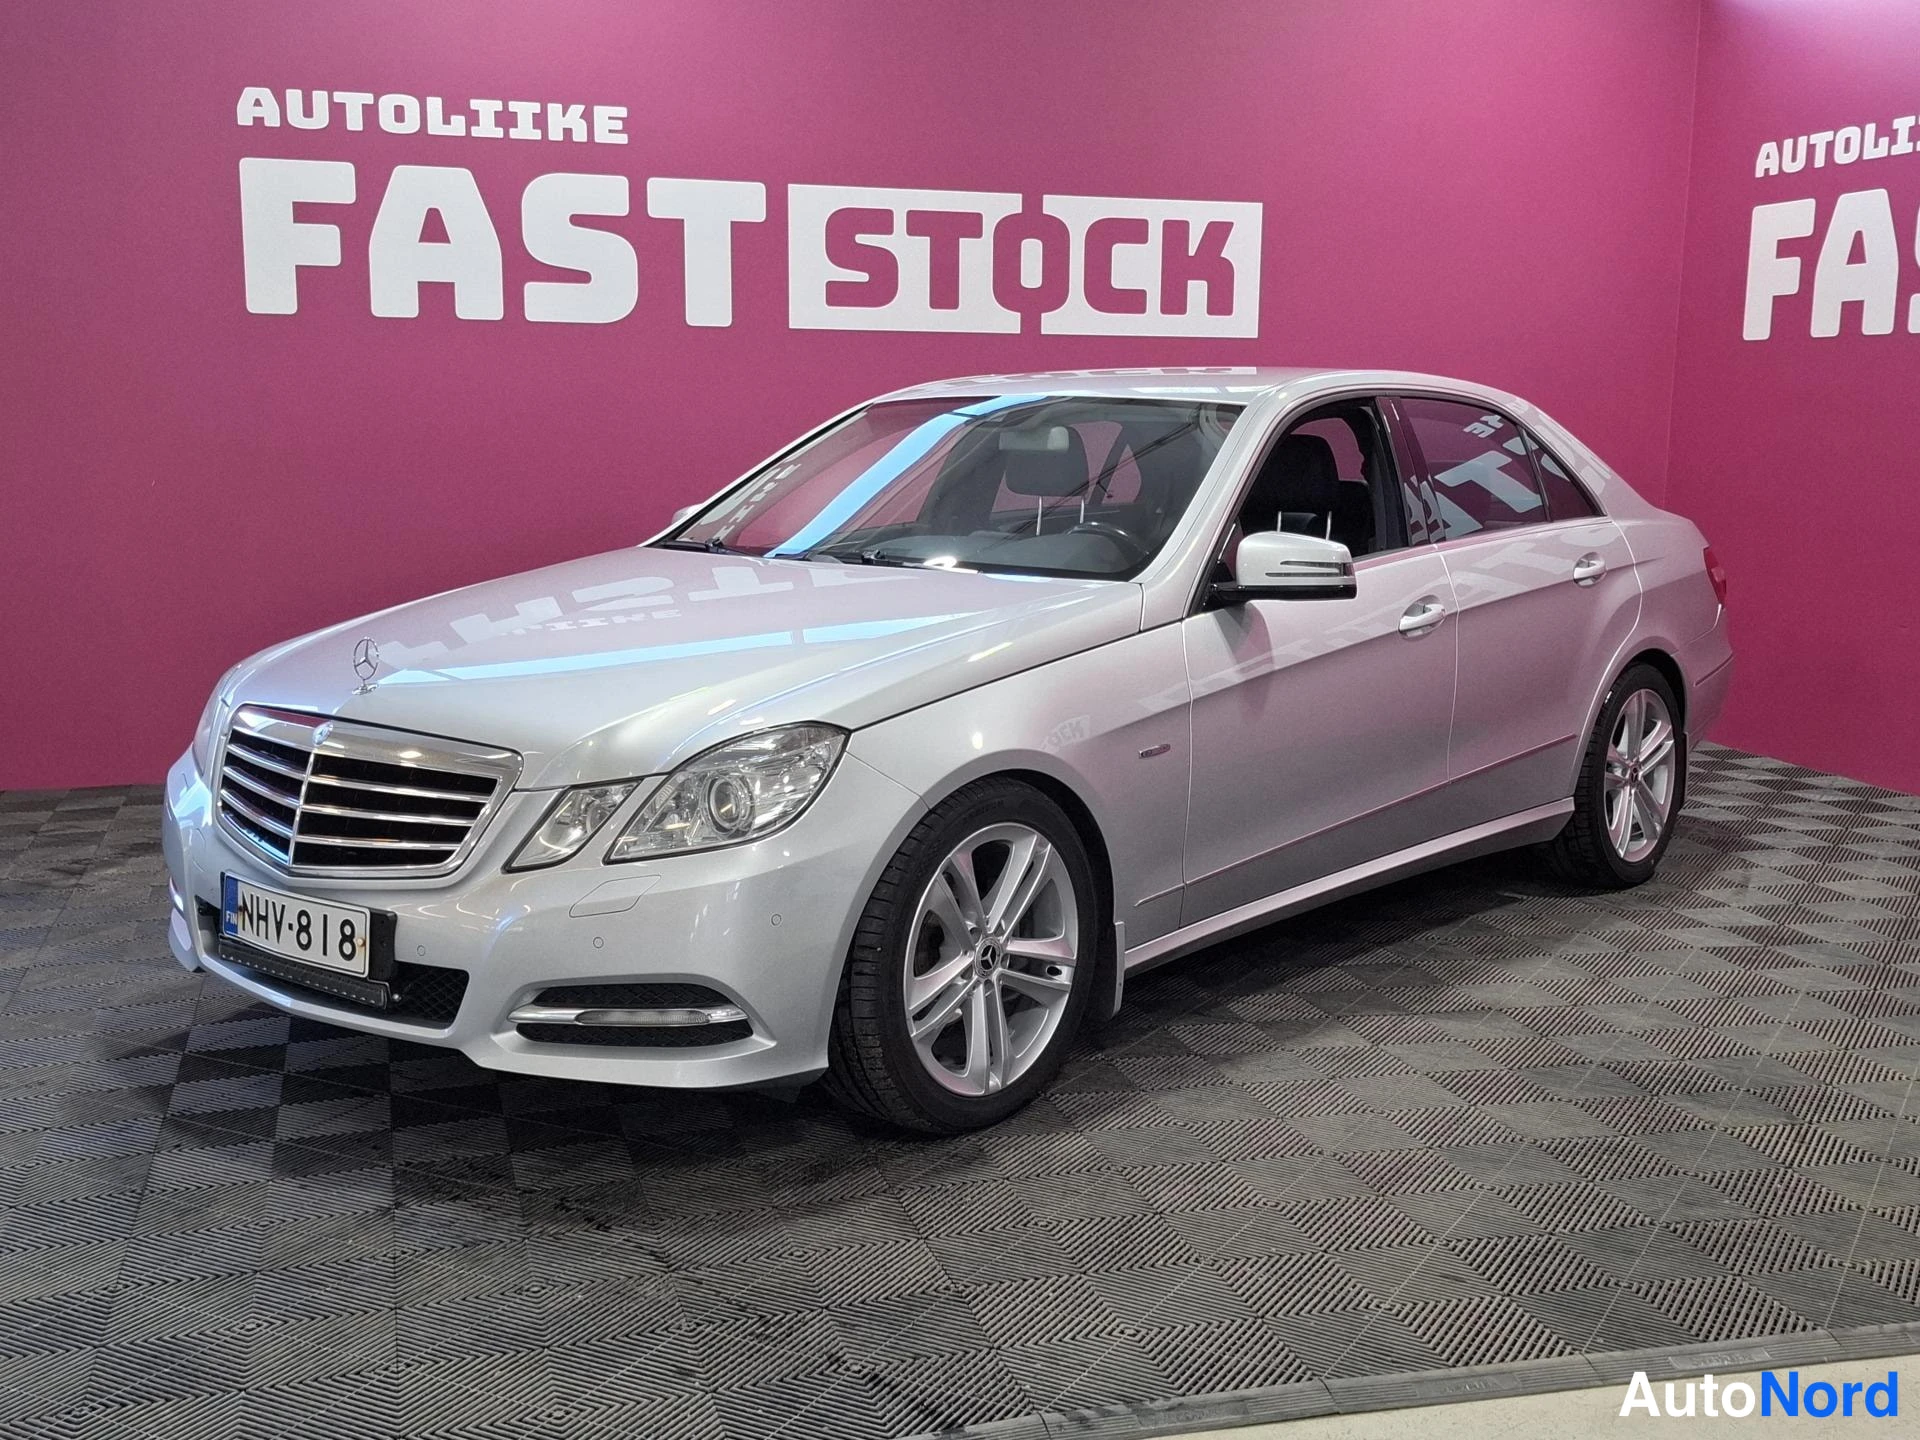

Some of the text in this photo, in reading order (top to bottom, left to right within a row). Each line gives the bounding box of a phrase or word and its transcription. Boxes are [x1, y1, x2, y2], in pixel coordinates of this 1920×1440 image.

[236, 86, 629, 145] AUTOLIIKE
[1755, 115, 1920, 178] AUTOLI
[239, 157, 1237, 328] FAST STOCK
[1742, 187, 1920, 341] FA
[225, 910, 238, 925] FIN
[241, 889, 357, 962] NHV-818
